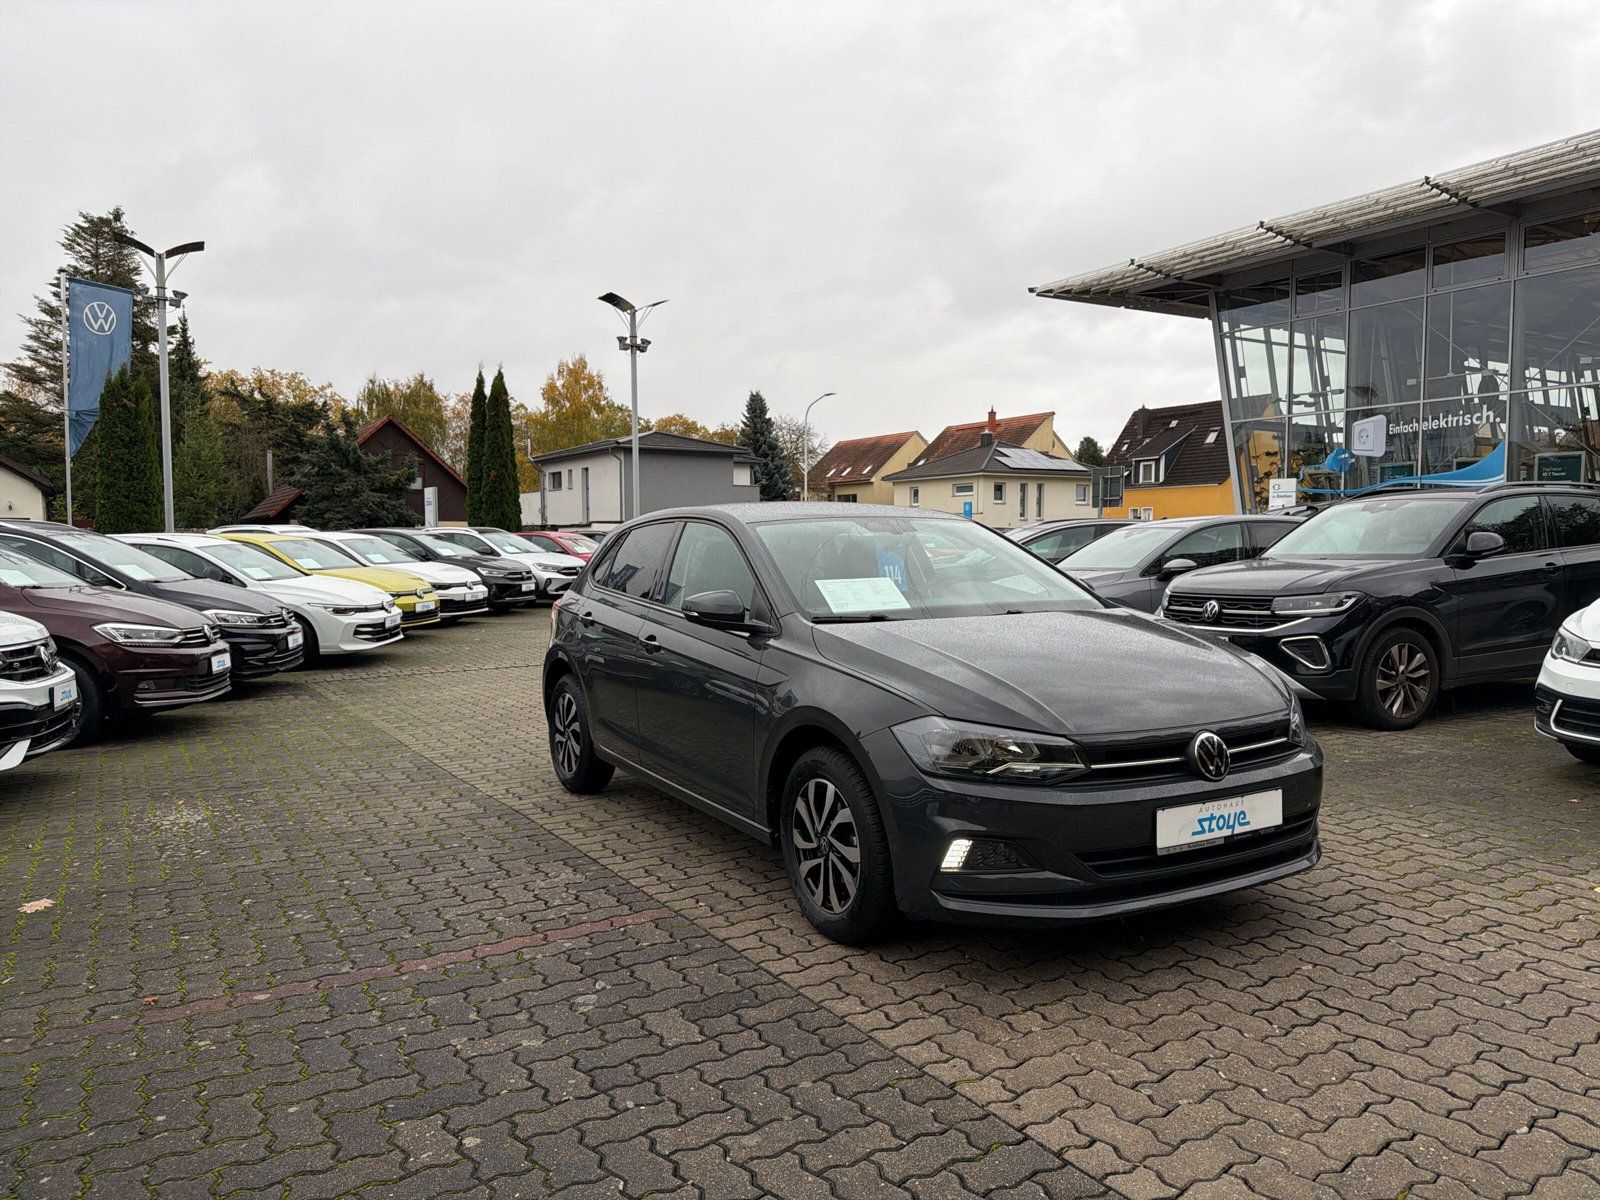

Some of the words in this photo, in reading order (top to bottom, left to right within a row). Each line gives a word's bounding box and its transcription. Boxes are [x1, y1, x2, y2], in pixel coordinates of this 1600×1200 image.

[1389, 418, 1419, 435] Einfach
[1422, 404, 1501, 430] elektrisch.
[884, 565, 902, 584] 114
[1199, 799, 1245, 813] AUTOHAUS
